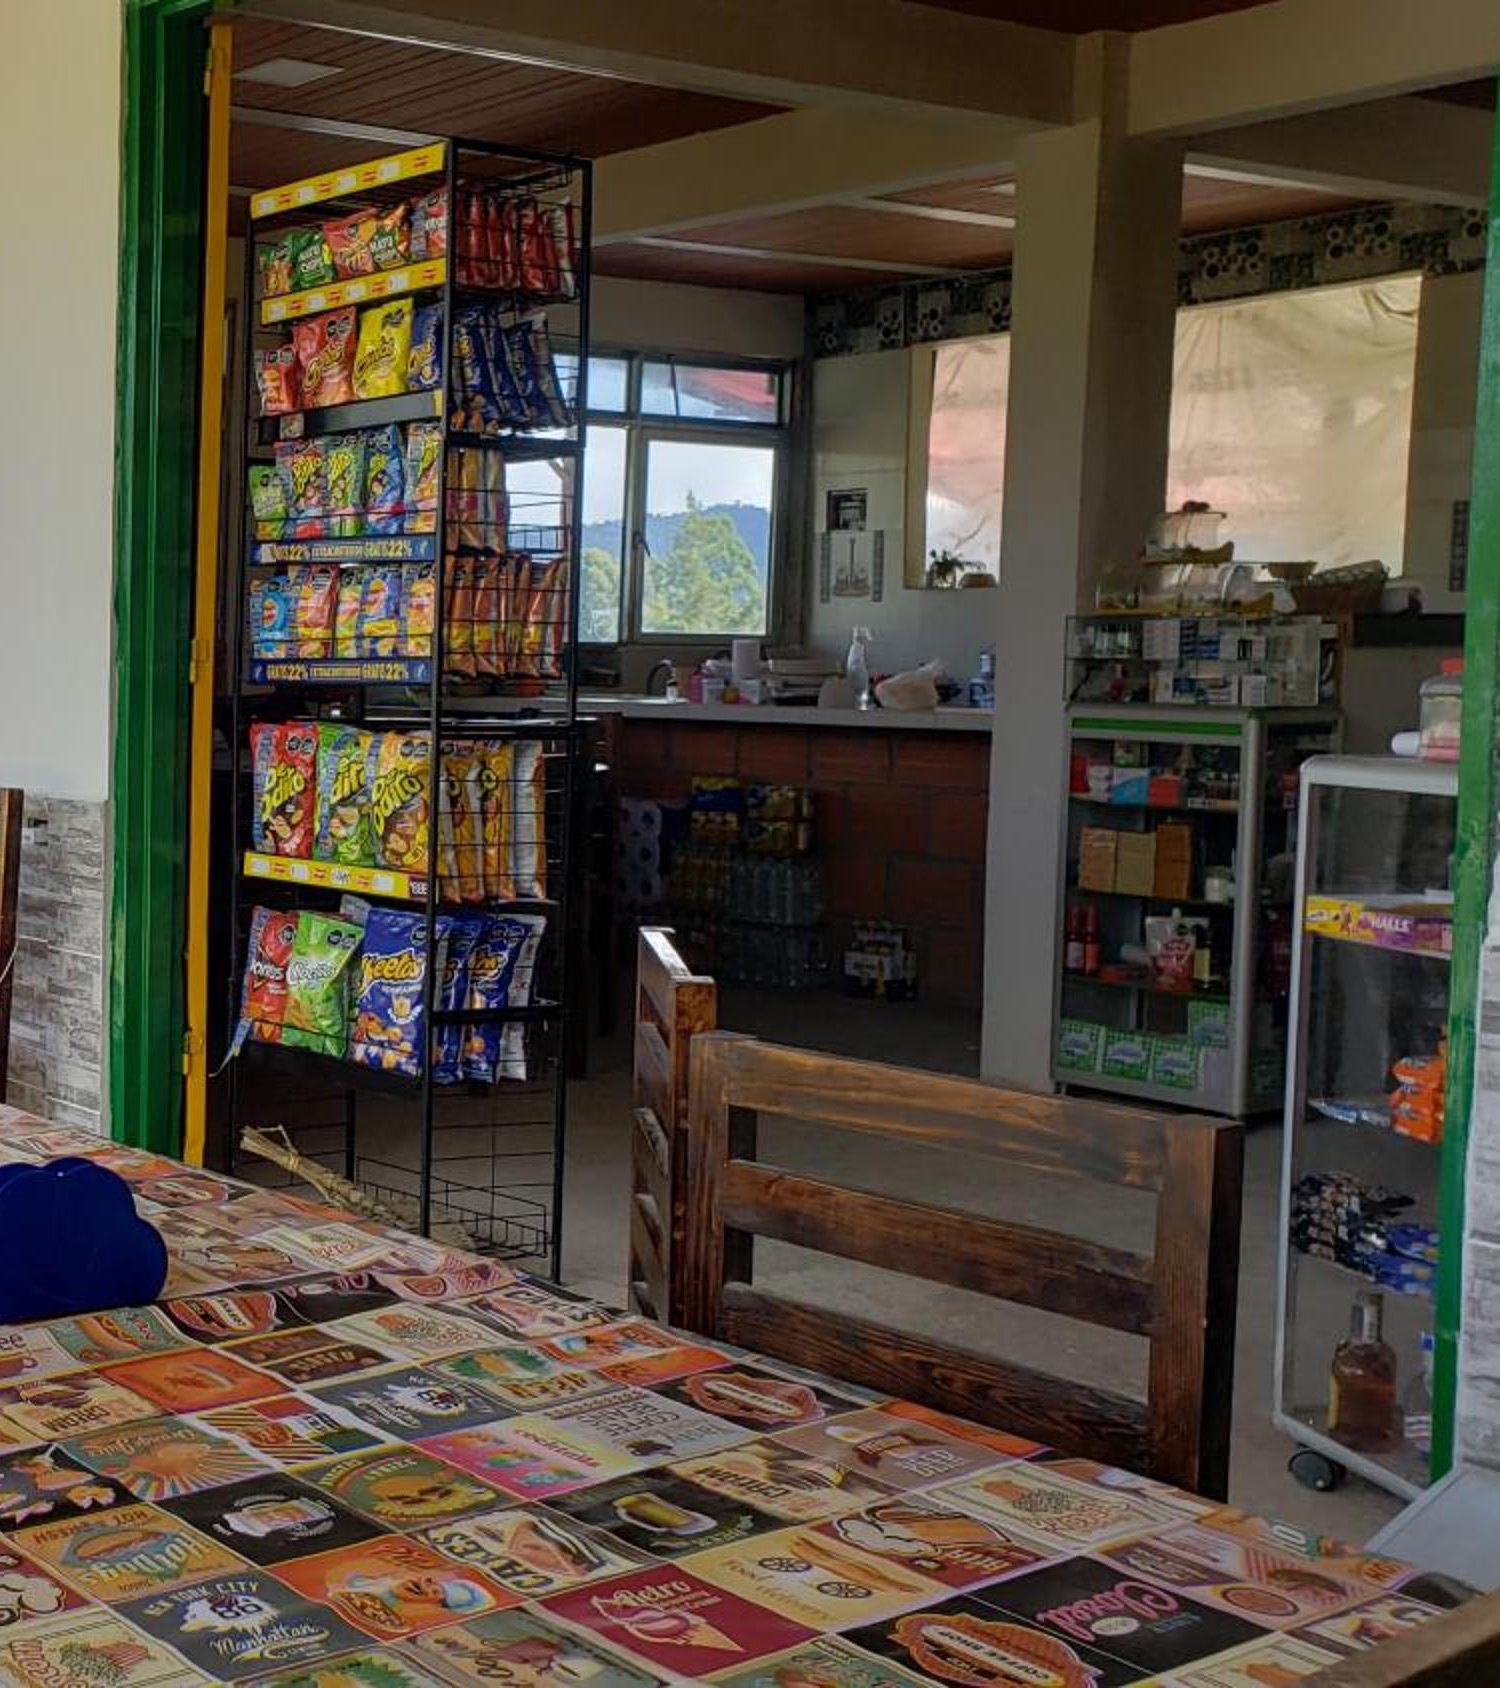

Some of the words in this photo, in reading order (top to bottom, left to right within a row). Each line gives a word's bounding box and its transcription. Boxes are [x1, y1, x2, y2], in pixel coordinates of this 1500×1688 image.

[1371, 916, 1412, 934] HALLS
[431, 1530, 555, 1590] CAKES
[1035, 1581, 1180, 1643] Closed
